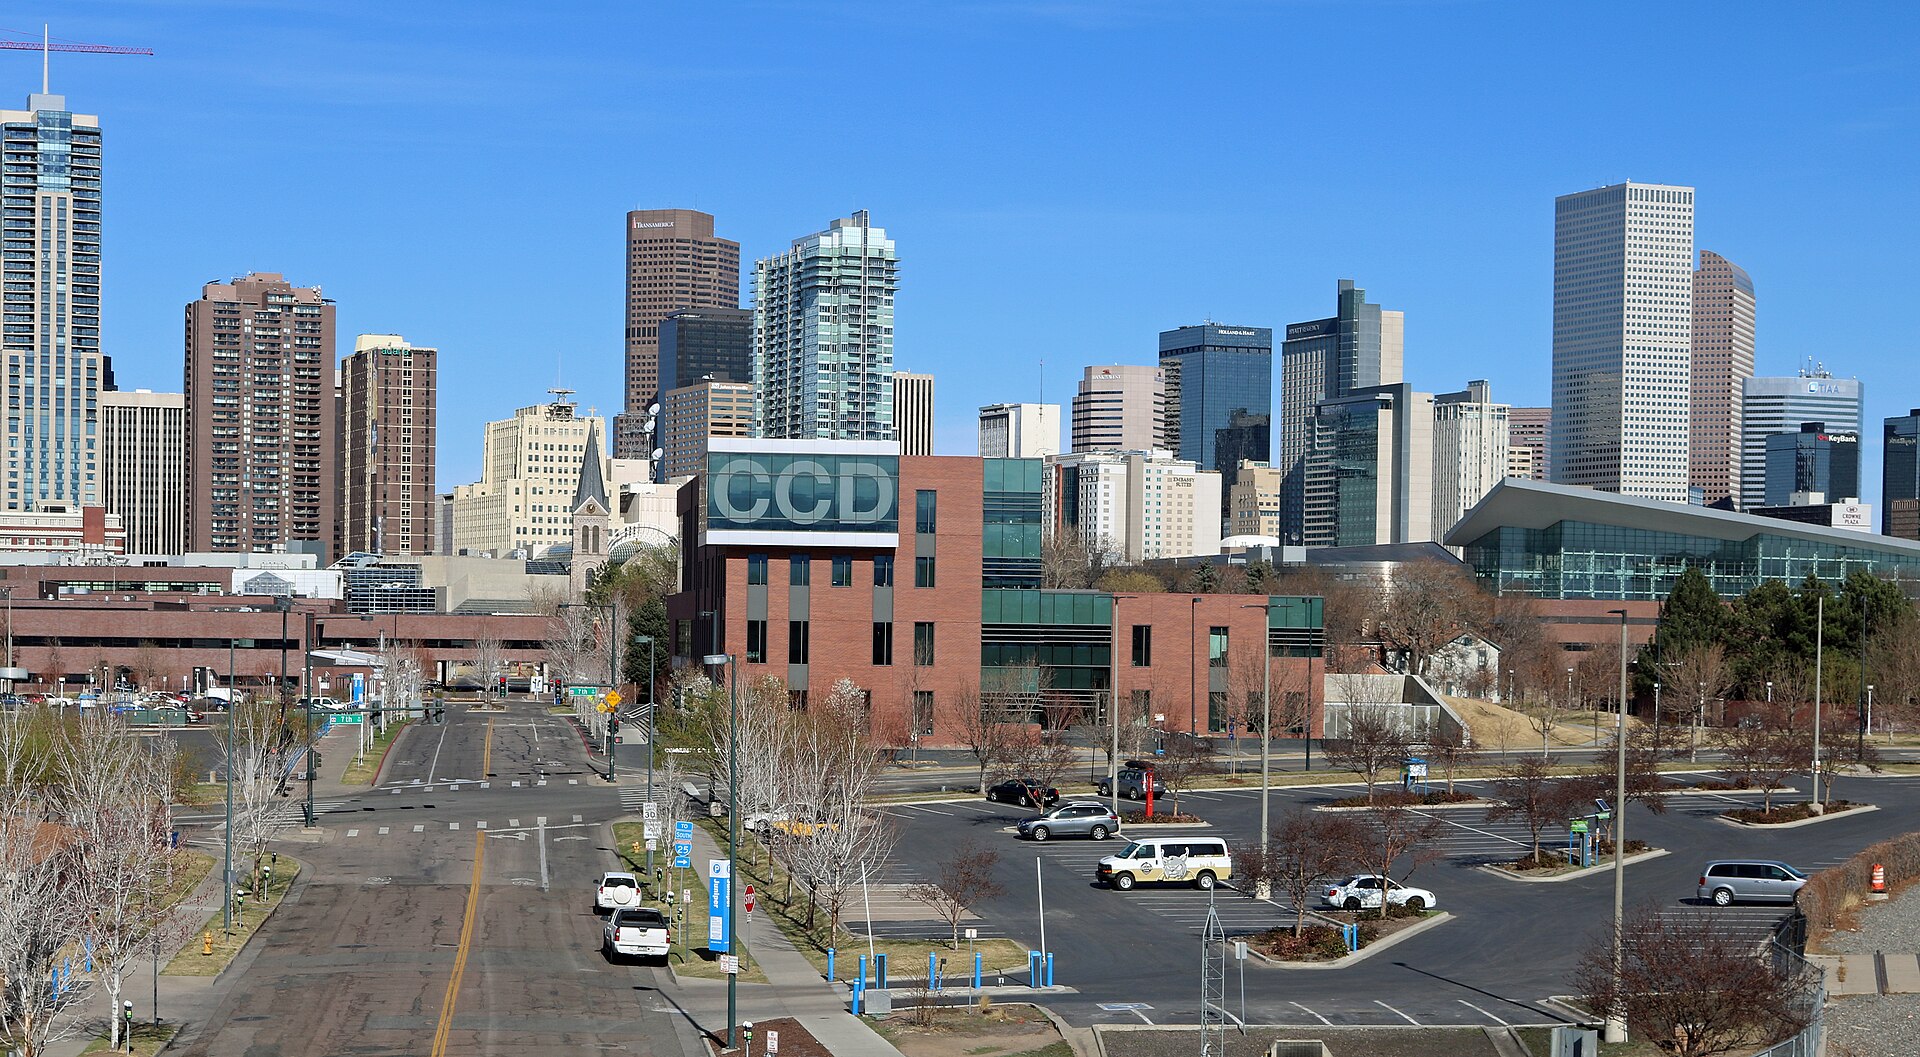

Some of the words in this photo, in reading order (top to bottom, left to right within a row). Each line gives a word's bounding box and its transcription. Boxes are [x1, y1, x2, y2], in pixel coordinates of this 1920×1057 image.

[1818, 383, 1839, 393] TIAA
[1828, 434, 1857, 444] KeyBank
[714, 459, 893, 525] CCD
[644, 811, 656, 819] 30
[677, 845, 689, 854] 25
[745, 893, 755, 904] STOP
